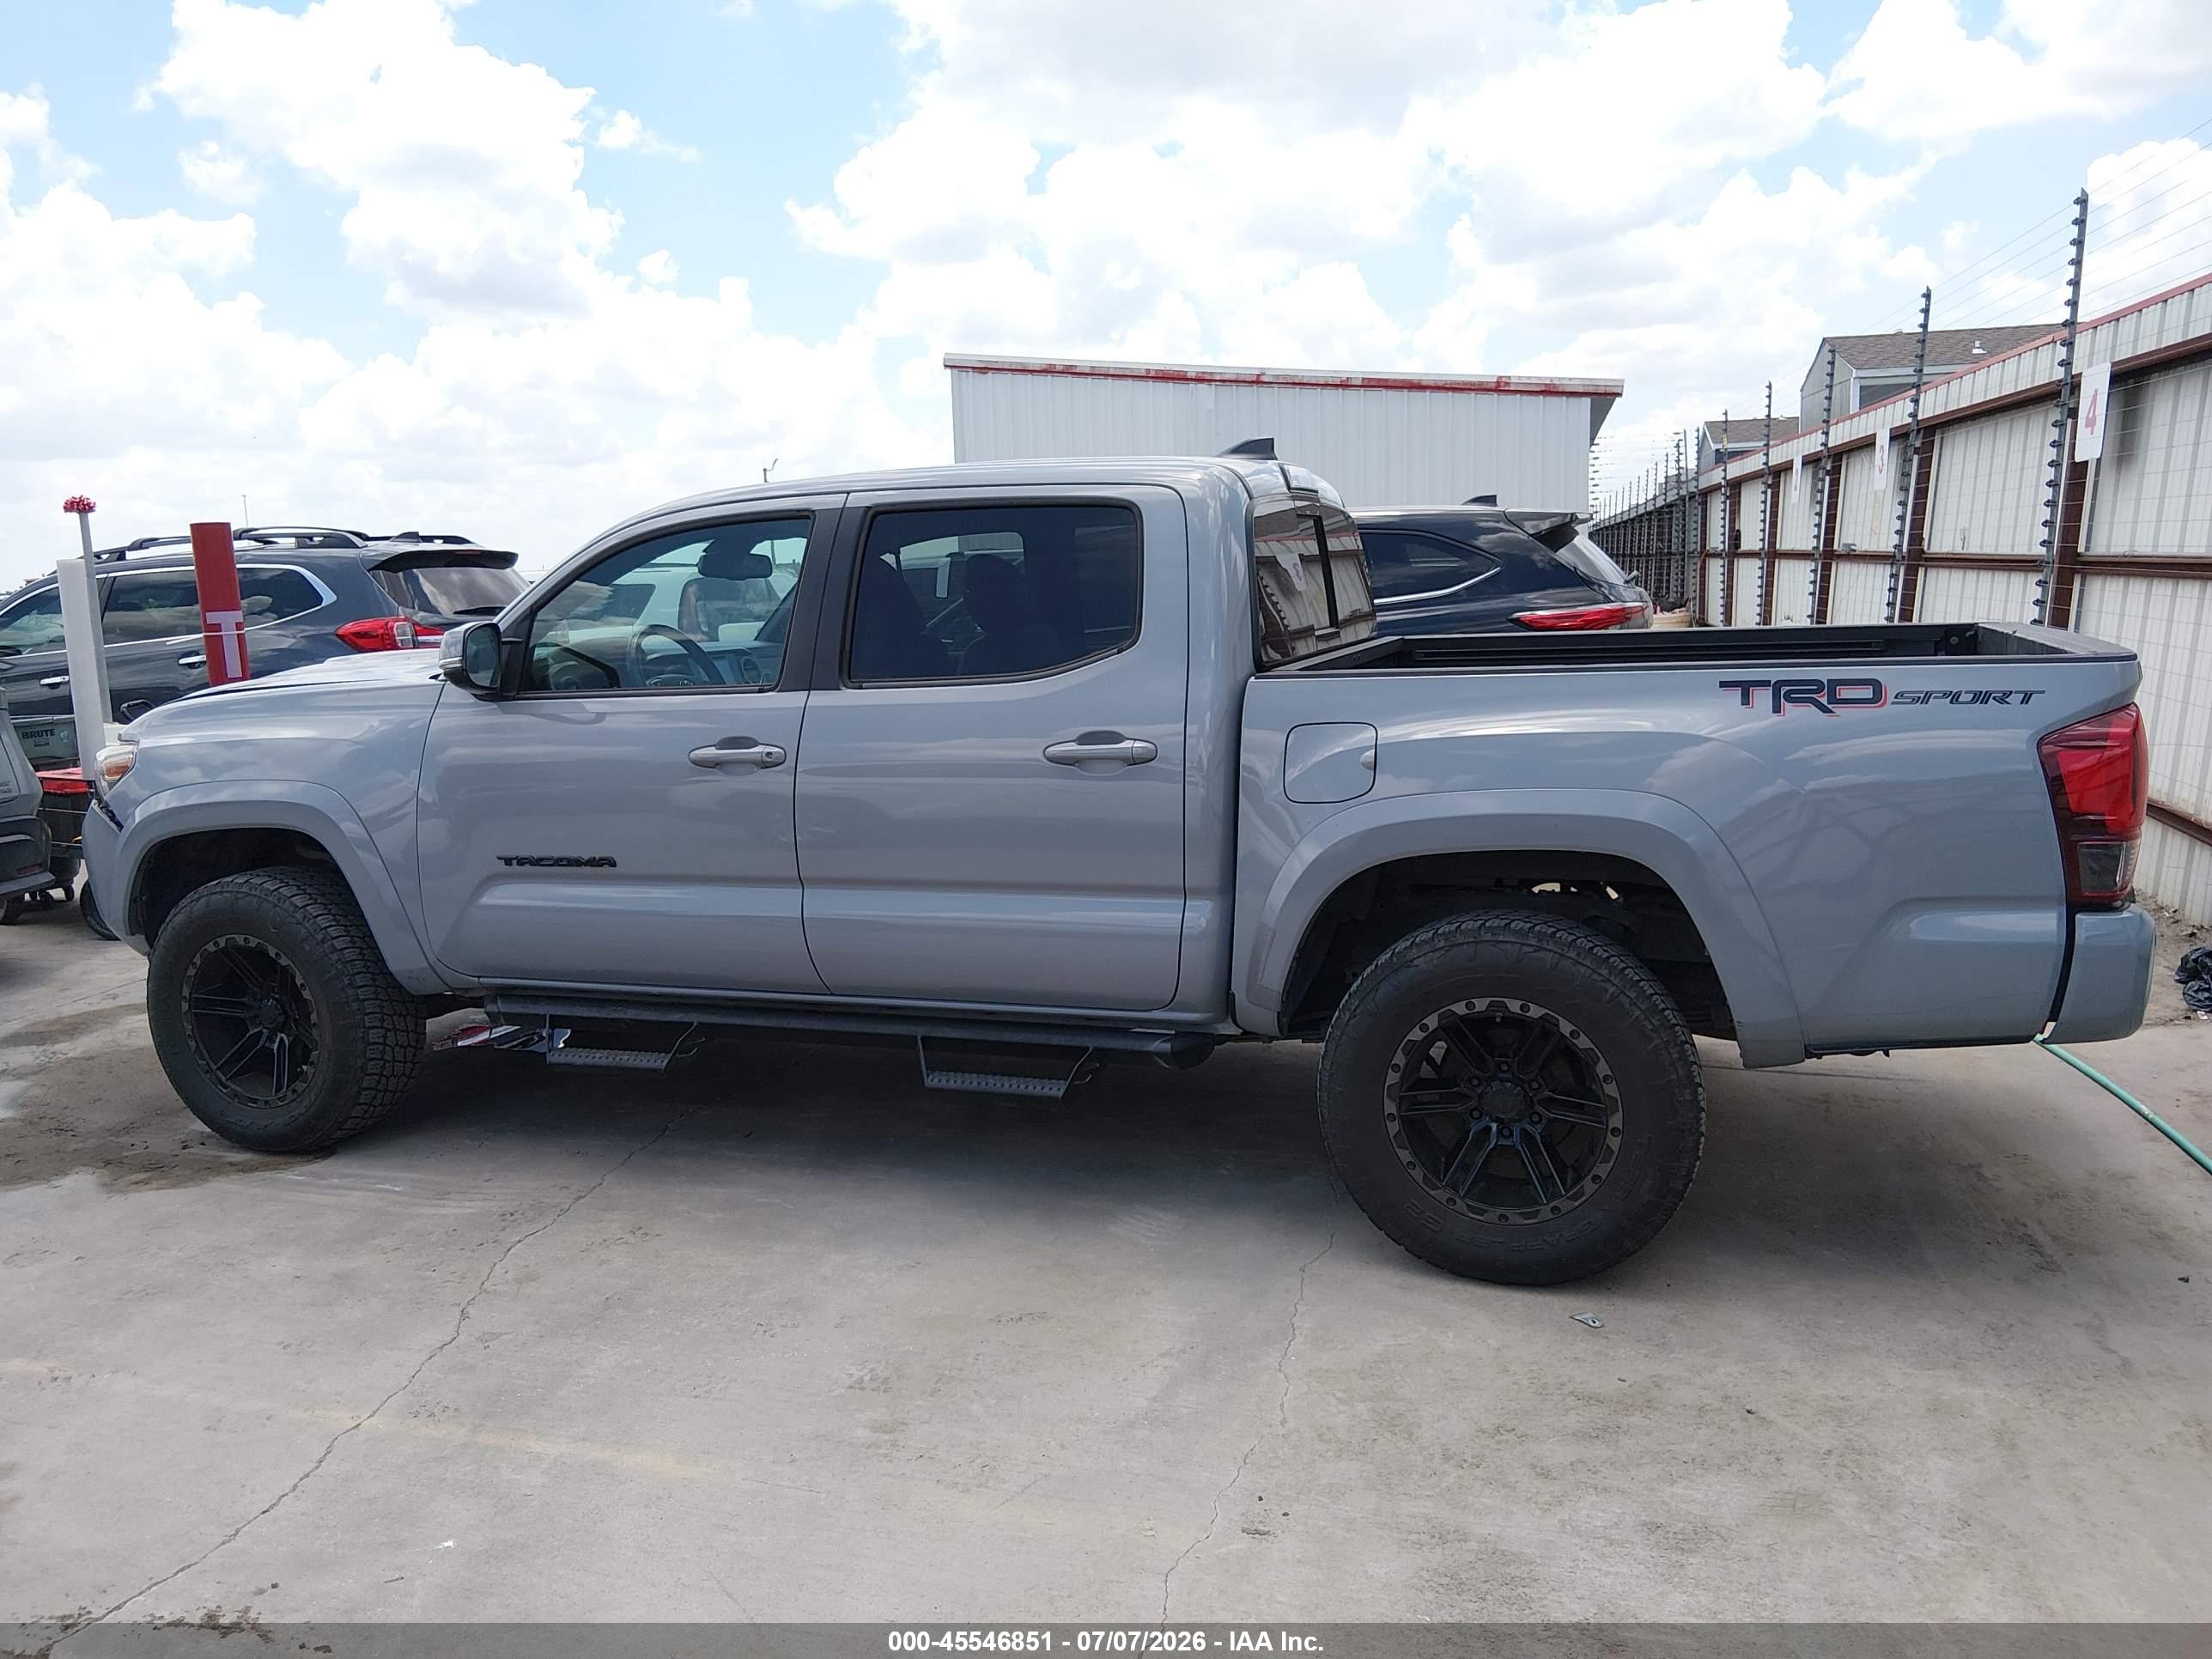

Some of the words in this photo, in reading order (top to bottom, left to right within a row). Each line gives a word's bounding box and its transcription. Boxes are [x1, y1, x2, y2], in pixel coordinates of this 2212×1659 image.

[2085, 387, 2099, 436] 4
[1878, 444, 1886, 475] 3
[206, 610, 244, 678] T
[1719, 678, 1887, 716] TRD
[1891, 690, 2045, 705] SPORT
[21, 729, 55, 739] BRUTE
[496, 855, 617, 868] TACOMA
